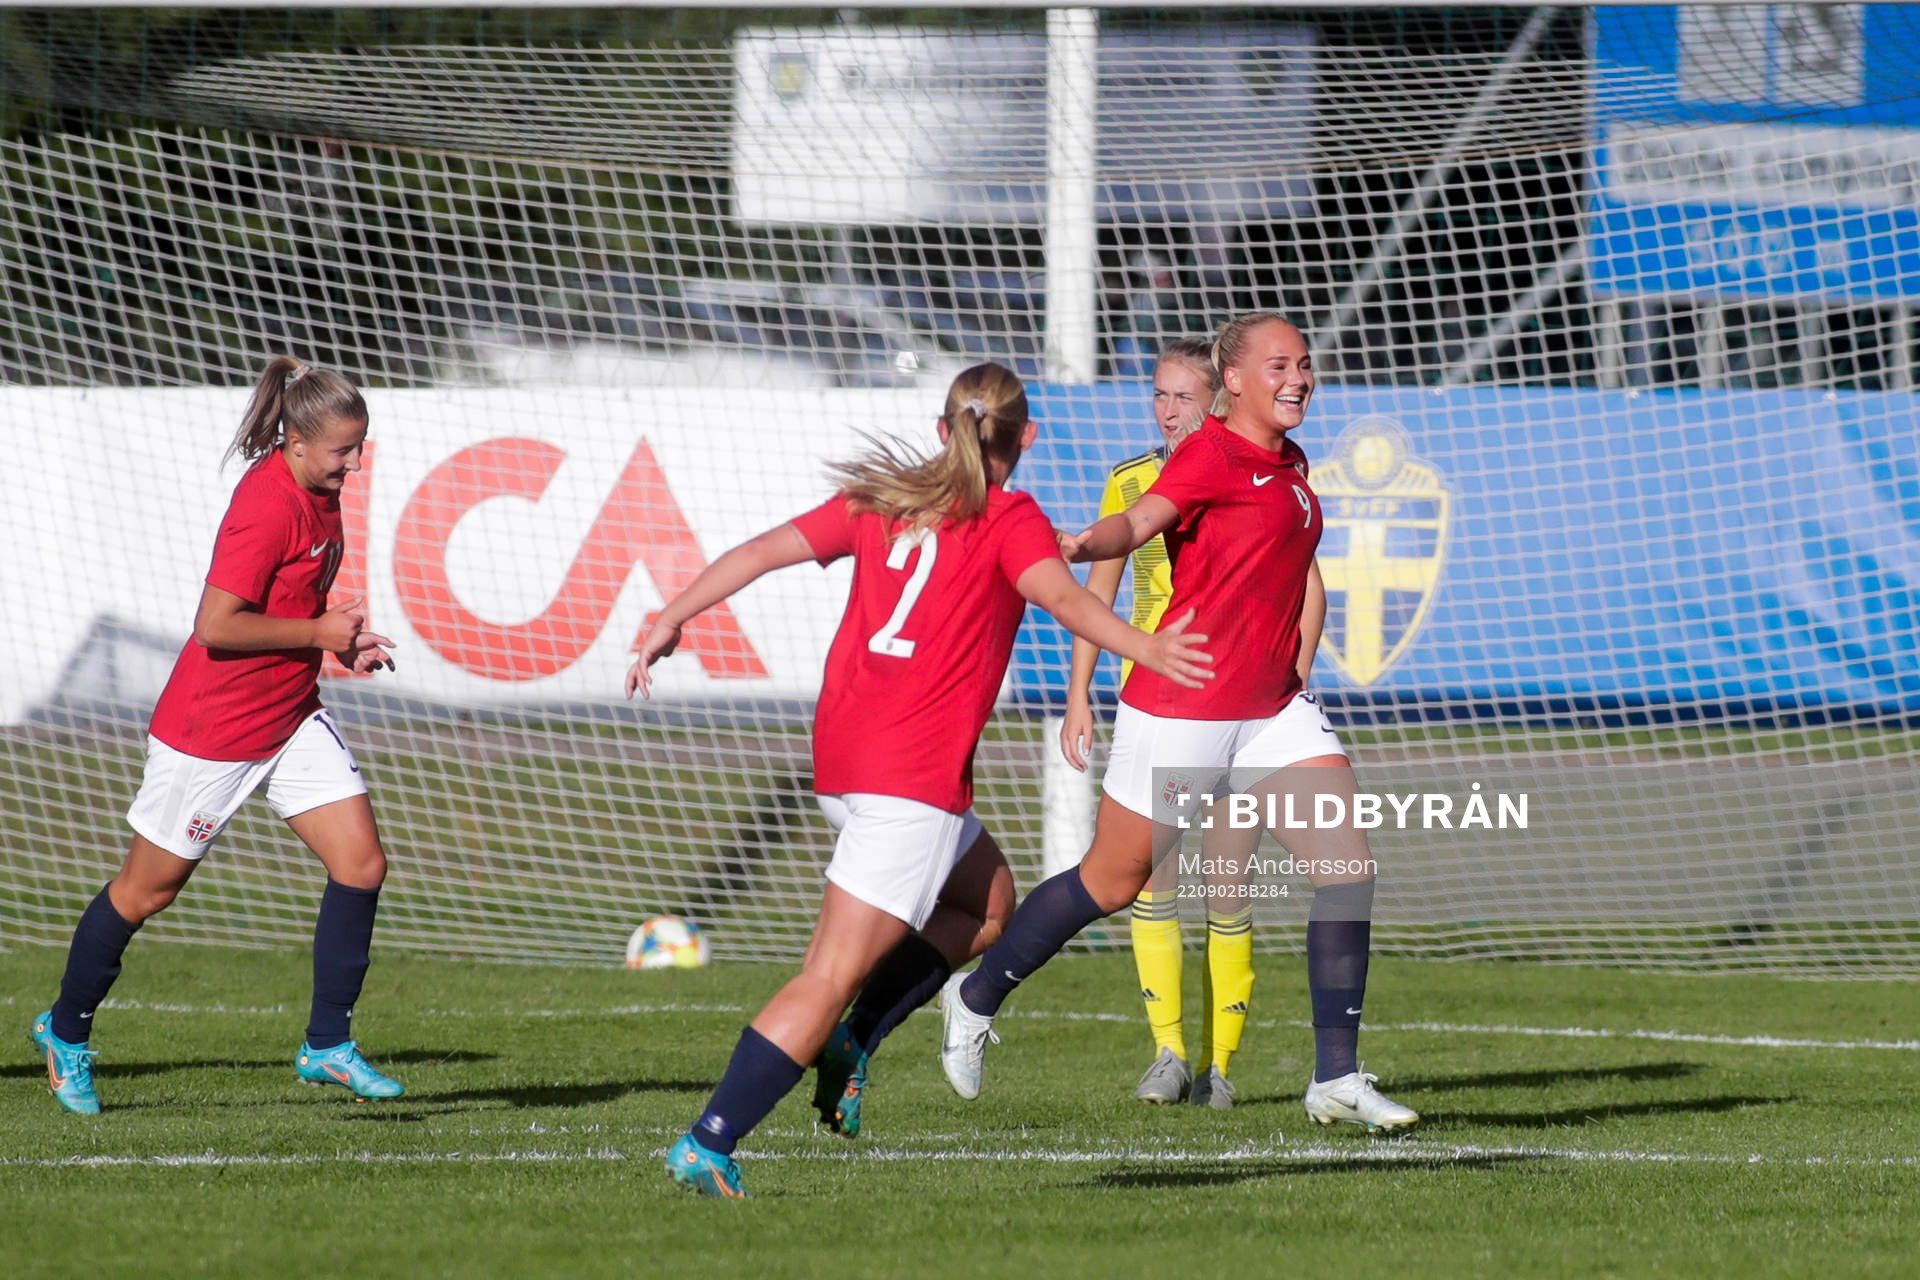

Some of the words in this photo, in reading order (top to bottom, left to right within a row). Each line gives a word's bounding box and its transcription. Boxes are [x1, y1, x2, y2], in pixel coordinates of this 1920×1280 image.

[319, 435, 772, 682] ICA
[1291, 484, 1312, 529] 9
[868, 527, 938, 658] 2
